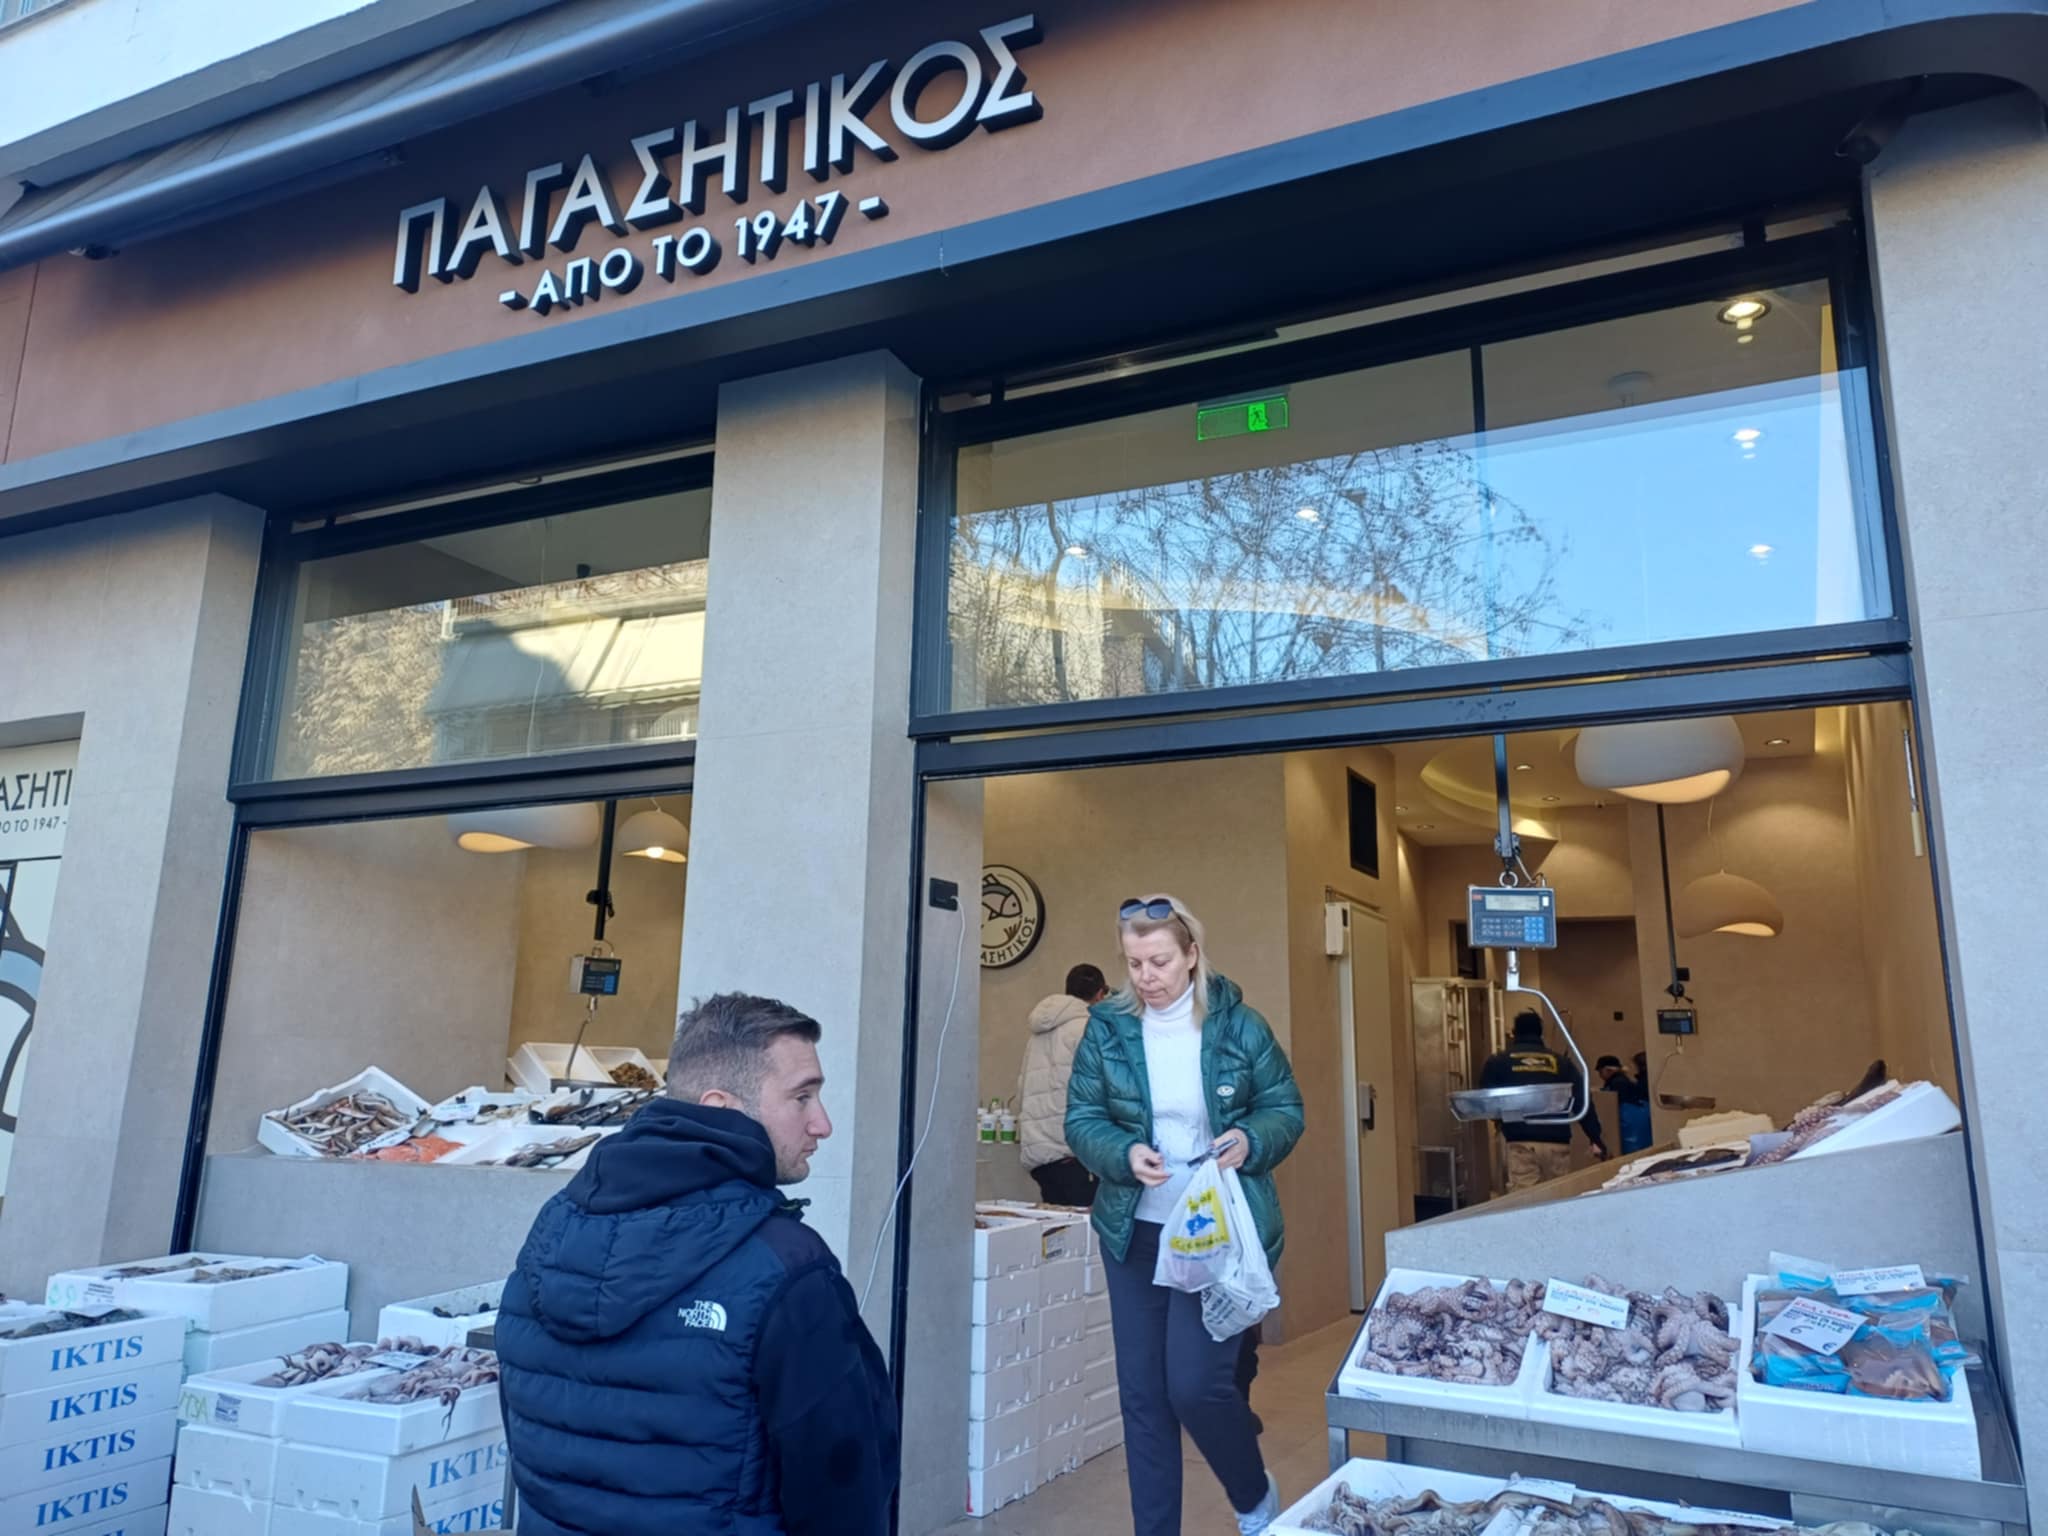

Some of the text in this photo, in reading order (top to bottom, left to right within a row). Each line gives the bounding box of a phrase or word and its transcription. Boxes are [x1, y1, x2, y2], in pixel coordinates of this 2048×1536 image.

[393, 14, 1040, 291] ΠΑΓΑΣΗΤΙΚΟΣ
[652, 227, 716, 276] ΤΟ
[735, 190, 846, 261] 1947
[33, 815, 60, 831] 1947
[678, 1307, 712, 1320] NORTH
[684, 1318, 712, 1329] FACE
[694, 1300, 713, 1311] THE
[51, 1335, 144, 1372] IKTIS
[48, 1383, 138, 1423] IKTIS
[43, 1429, 136, 1472] IKTIS
[428, 1440, 507, 1488] IKTIS
[36, 1482, 129, 1527] IKTIS
[427, 1499, 503, 1535] KTIS
